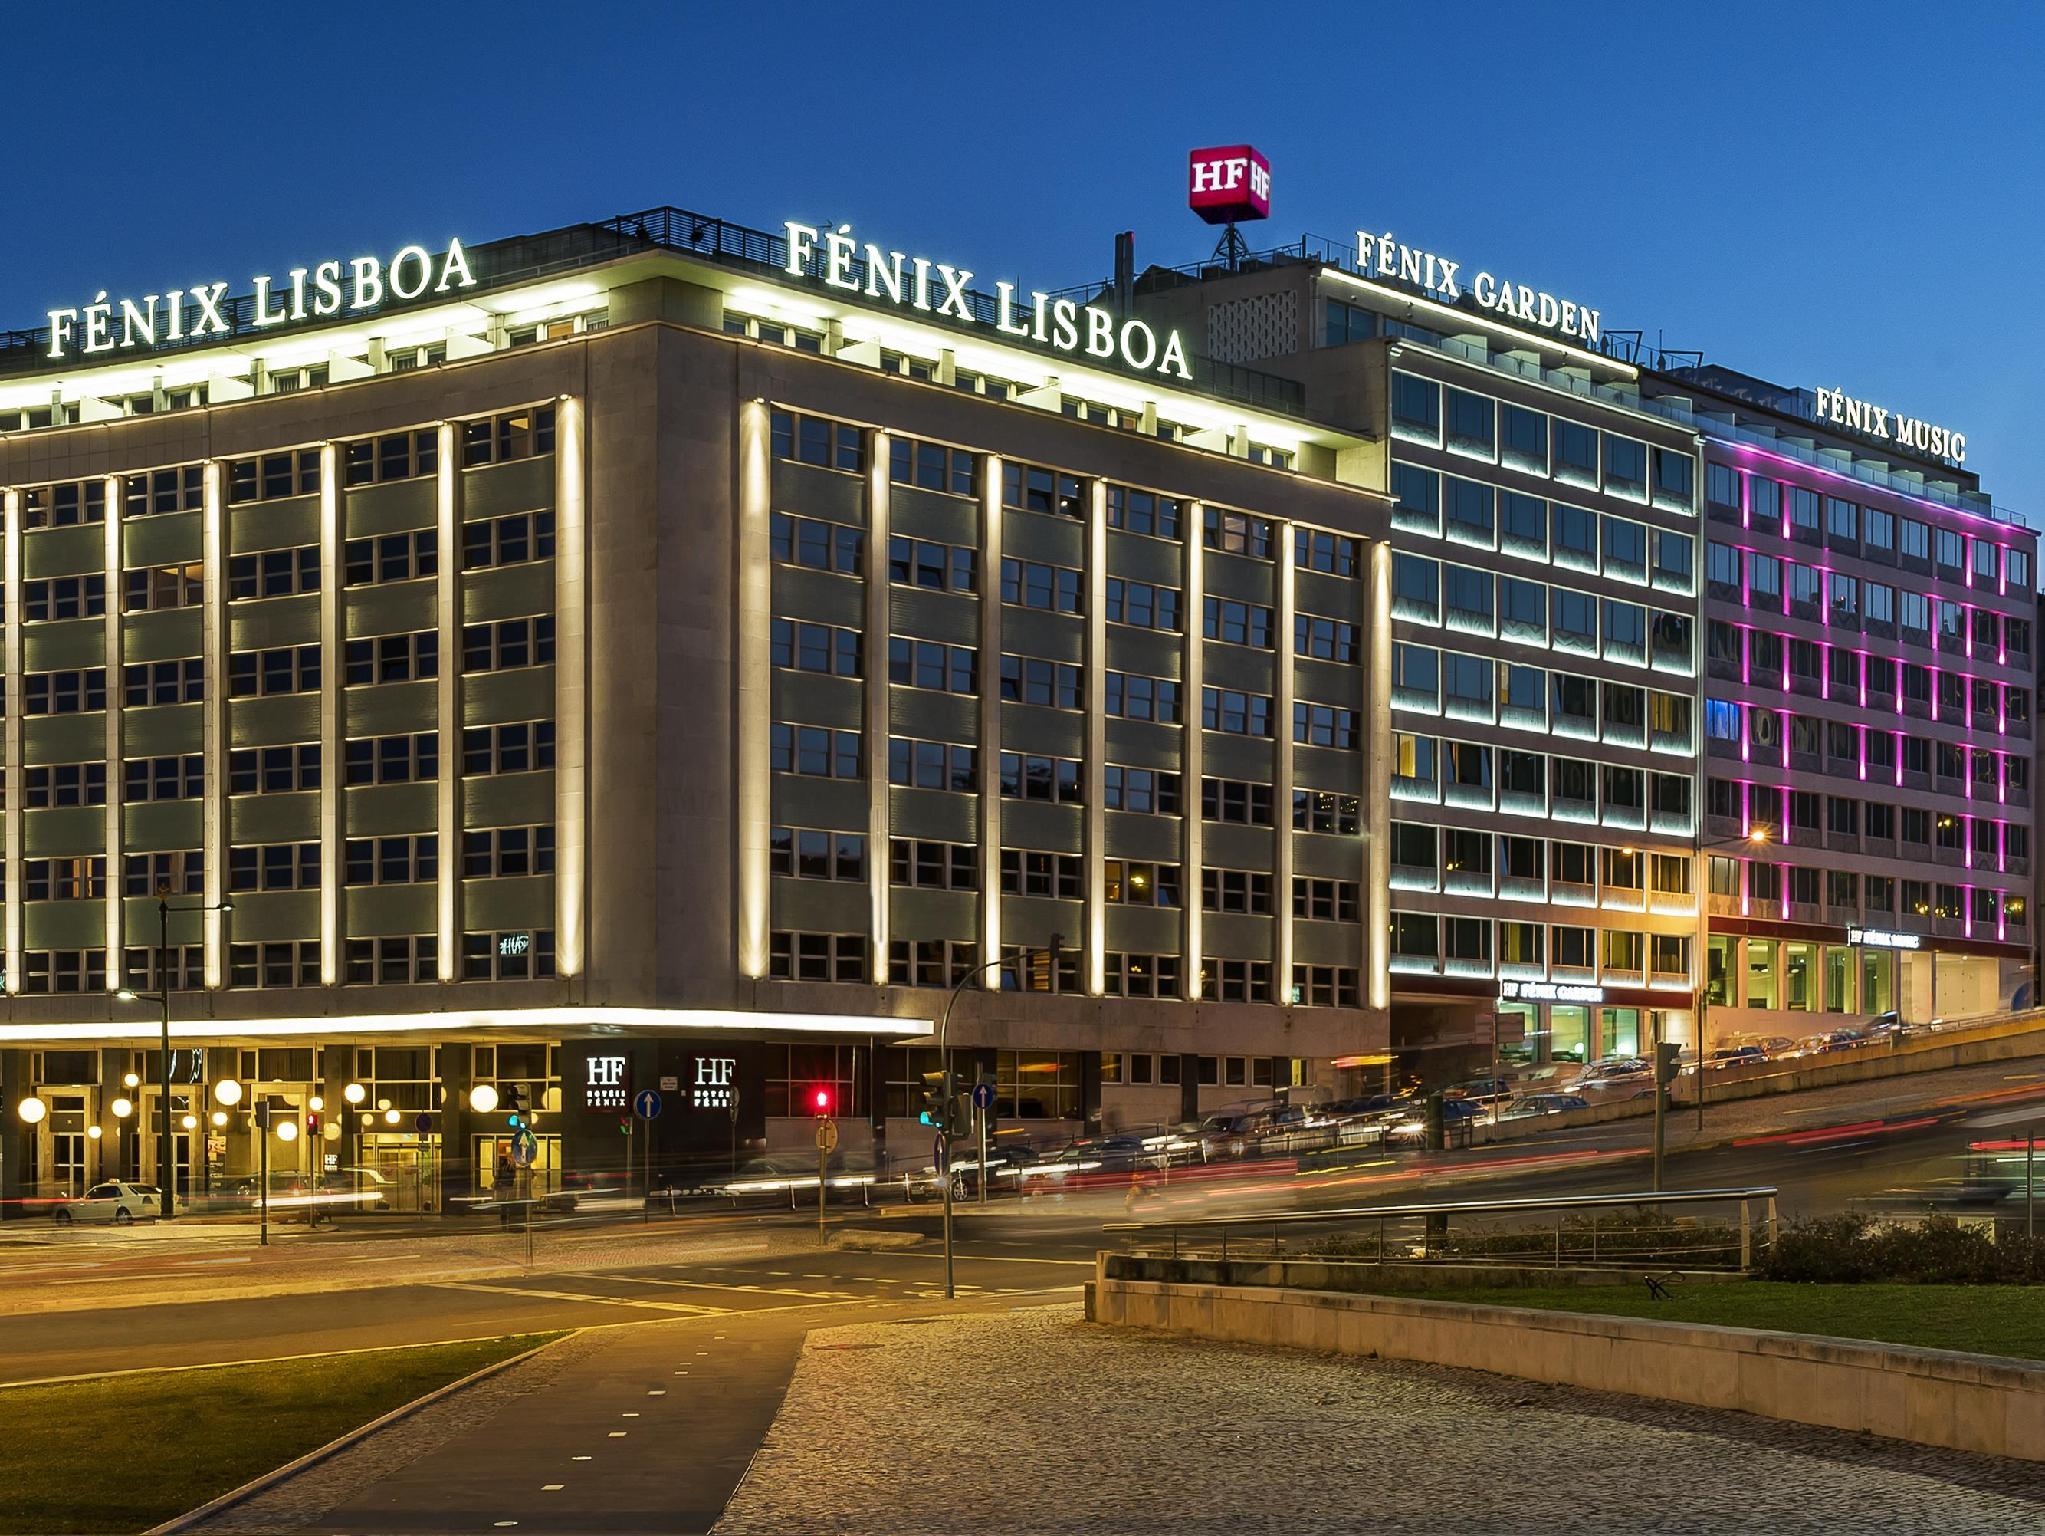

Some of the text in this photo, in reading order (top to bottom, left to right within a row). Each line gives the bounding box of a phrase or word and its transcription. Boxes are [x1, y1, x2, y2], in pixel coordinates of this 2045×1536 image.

[1191, 157, 1248, 193] HF
[1250, 159, 1270, 201] HF
[46, 236, 478, 358] FÉNIX LISBOA
[783, 220, 1194, 381] FÉNIX LISBOA
[1355, 231, 1601, 343] FÉNIX GARDEN
[1816, 386, 1966, 463] FÉNIX MUSIC
[586, 1056, 626, 1085] HF
[694, 1057, 736, 1085] HF
